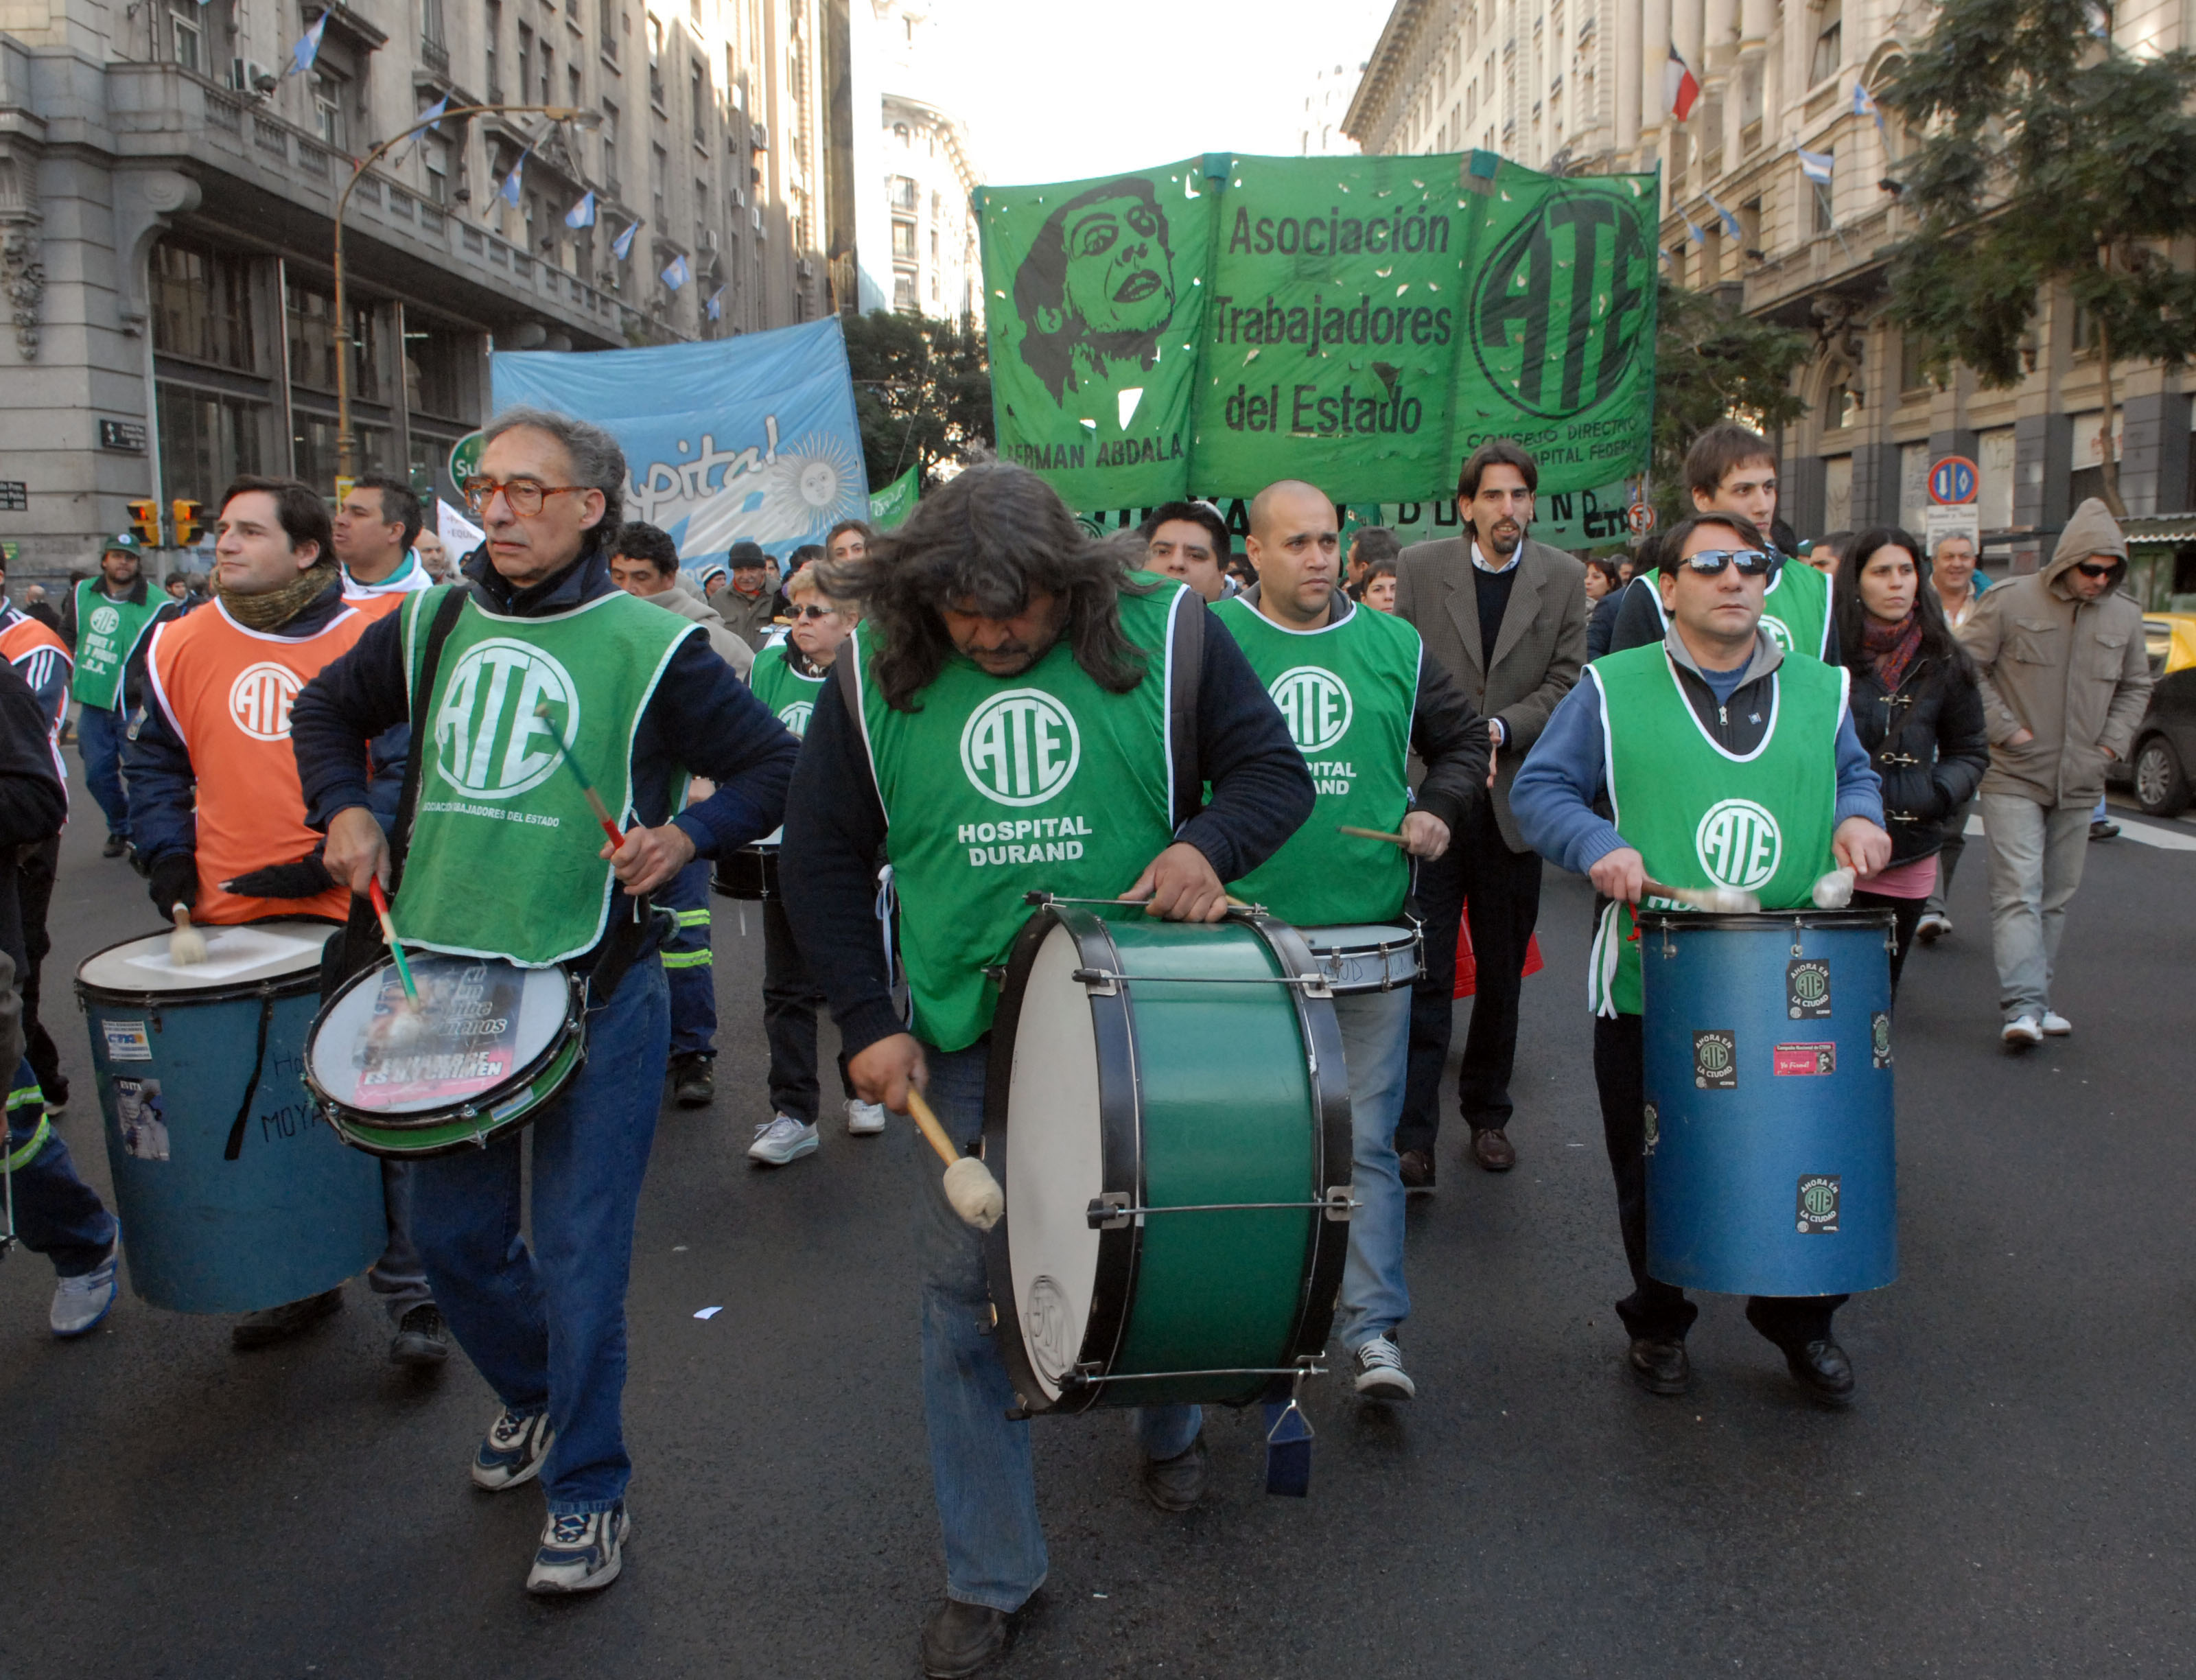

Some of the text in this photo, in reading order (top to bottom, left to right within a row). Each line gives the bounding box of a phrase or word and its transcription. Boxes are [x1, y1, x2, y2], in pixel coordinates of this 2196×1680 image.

[1228, 206, 1450, 255] Asociación
[1480, 199, 1646, 410] ATE
[1213, 295, 1452, 357] Trabajadores
[1225, 384, 1423, 434] del Estado
[1096, 433, 1184, 468] ABDALA
[1531, 446, 1583, 468] APITAL
[456, 459, 479, 477] Su
[1398, 489, 1598, 527] DUND
[236, 669, 298, 734] ATE
[1273, 673, 1342, 745] ATE
[439, 648, 567, 789] ATE
[972, 699, 1066, 796] ATE
[507, 810, 524, 823] DEL
[524, 813, 560, 828] ESTADO
[958, 816, 1093, 843] HOSPITAL
[969, 841, 1084, 866] DURAND
[1704, 807, 1775, 885] ATE
[1790, 963, 1829, 979] AHORA EN
[1799, 976, 1822, 997] ATE
[1791, 994, 1829, 1007] LA CIUDAD
[1696, 1034, 1733, 1049] AHORA EN
[1703, 1045, 1725, 1066] ATE
[1696, 1065, 1733, 1077] LA CIUDAD
[1801, 1178, 1838, 1193] AHORA EN
[1808, 1189, 1830, 1213] ATE
[1799, 1210, 1836, 1223] LA CIUDAD
